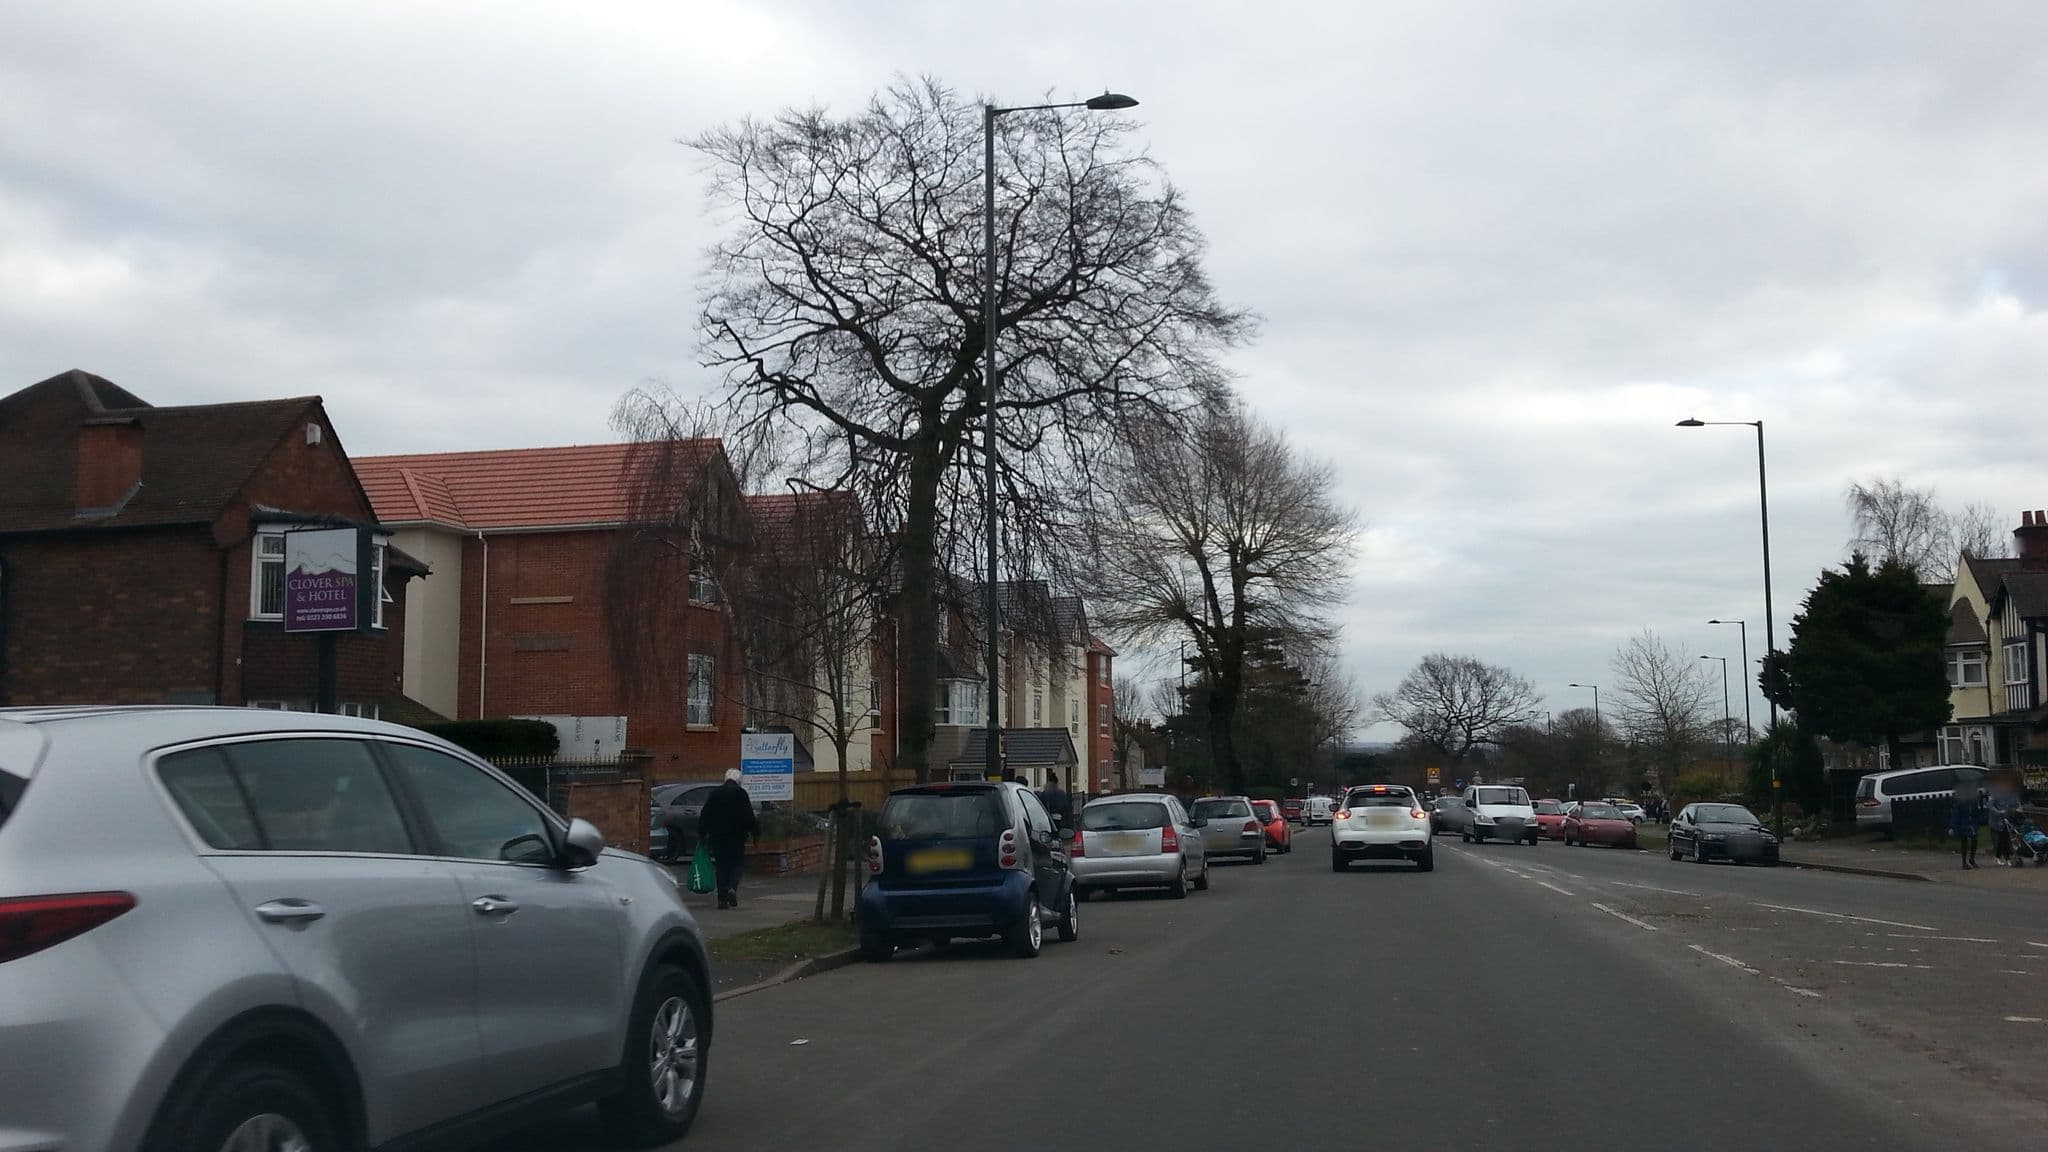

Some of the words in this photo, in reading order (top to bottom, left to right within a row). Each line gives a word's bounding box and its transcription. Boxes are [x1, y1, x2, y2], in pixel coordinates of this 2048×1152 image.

[289, 578, 333, 590] CLOVER
[335, 576, 354, 588] SPA
[296, 591, 305, 602] &
[309, 590, 347, 601] HOTEL
